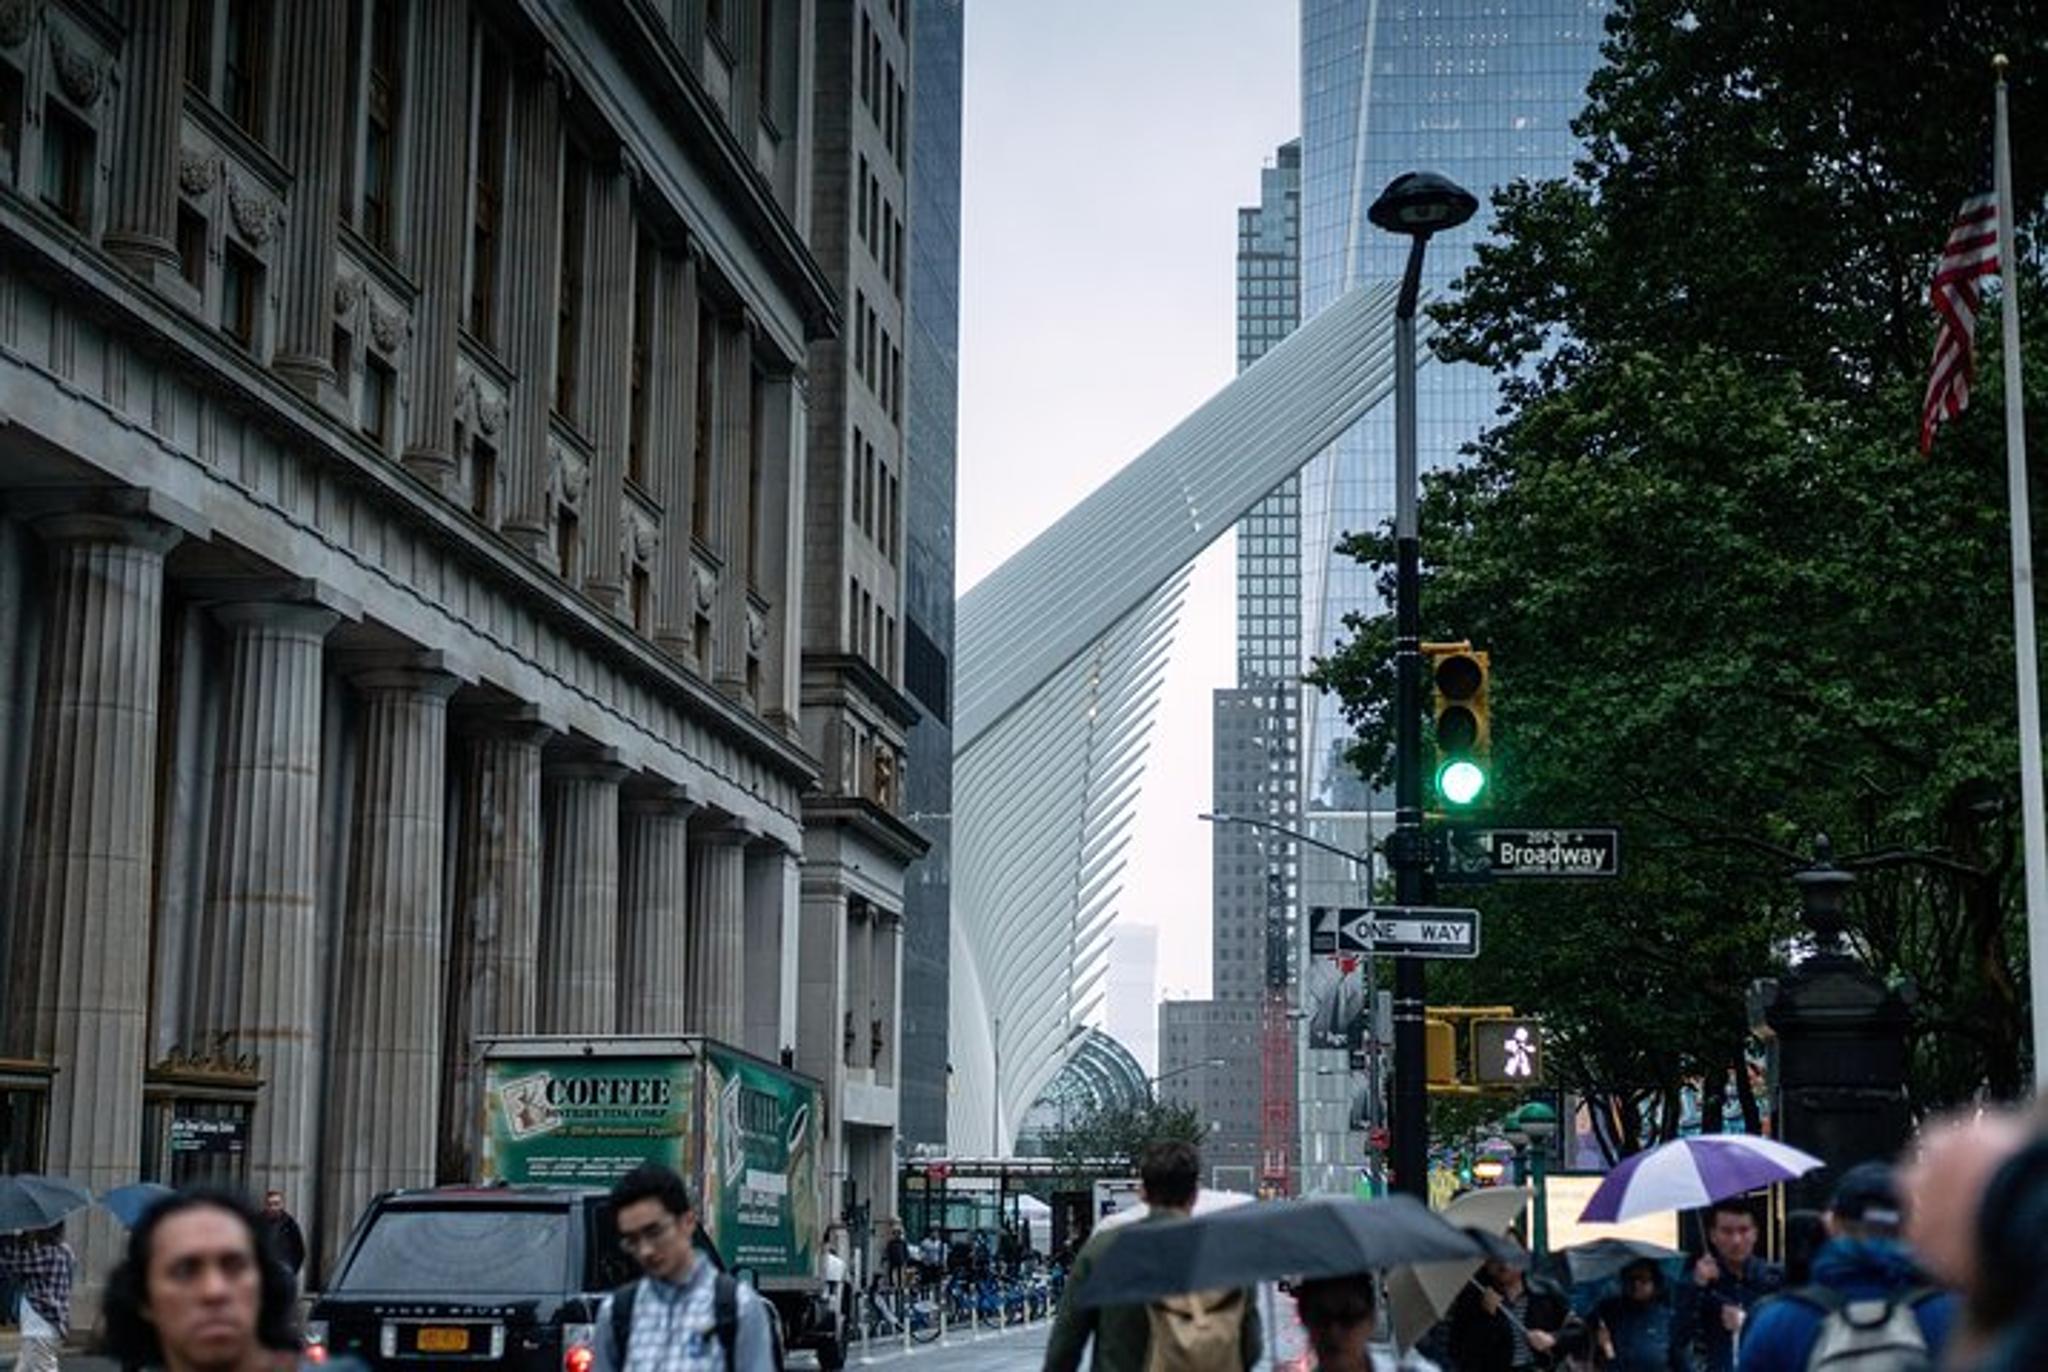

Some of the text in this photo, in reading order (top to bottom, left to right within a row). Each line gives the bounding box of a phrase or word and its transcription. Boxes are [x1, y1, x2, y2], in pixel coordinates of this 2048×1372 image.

[1500, 842, 1606, 869] Broadway
[1356, 922, 1464, 941] ONE WAY
[546, 1079, 670, 1105] COFFEE
